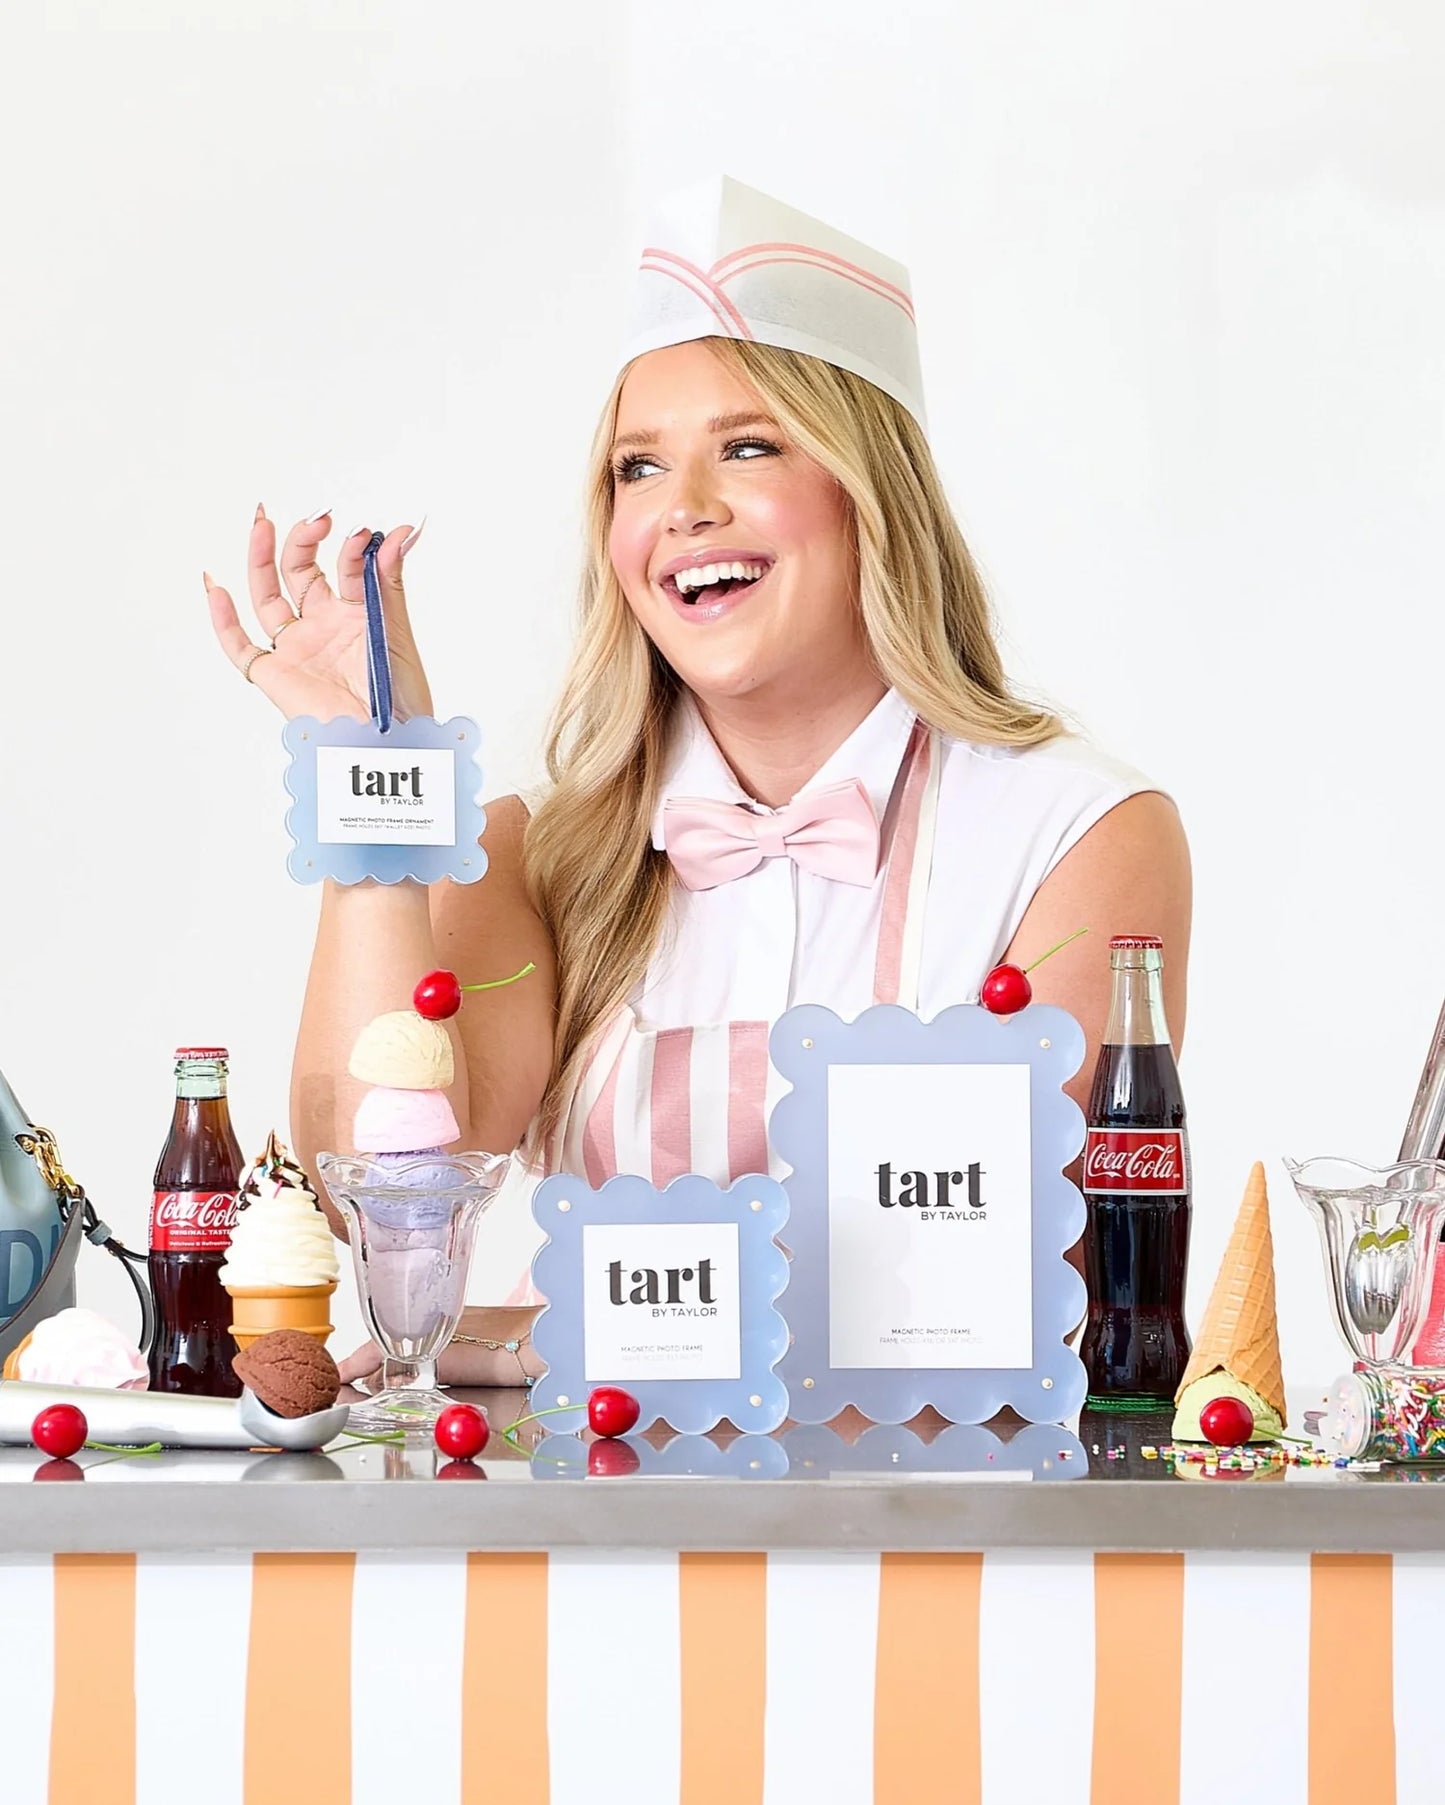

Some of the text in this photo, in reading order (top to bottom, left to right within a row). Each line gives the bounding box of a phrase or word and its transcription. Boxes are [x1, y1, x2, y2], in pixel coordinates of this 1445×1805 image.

[348, 764, 424, 798] tart
[393, 798, 424, 806] TAYLOR
[1087, 1143, 1177, 1179] Coca-Cola
[873, 1161, 987, 1209] tart
[920, 1211, 987, 1221] BY TAYLOR
[604, 1258, 717, 1306] tart
[651, 1307, 717, 1318] BY TAYLOR
[891, 1328, 924, 1336] MAGNETIC
[926, 1328, 949, 1336] PHOTO
